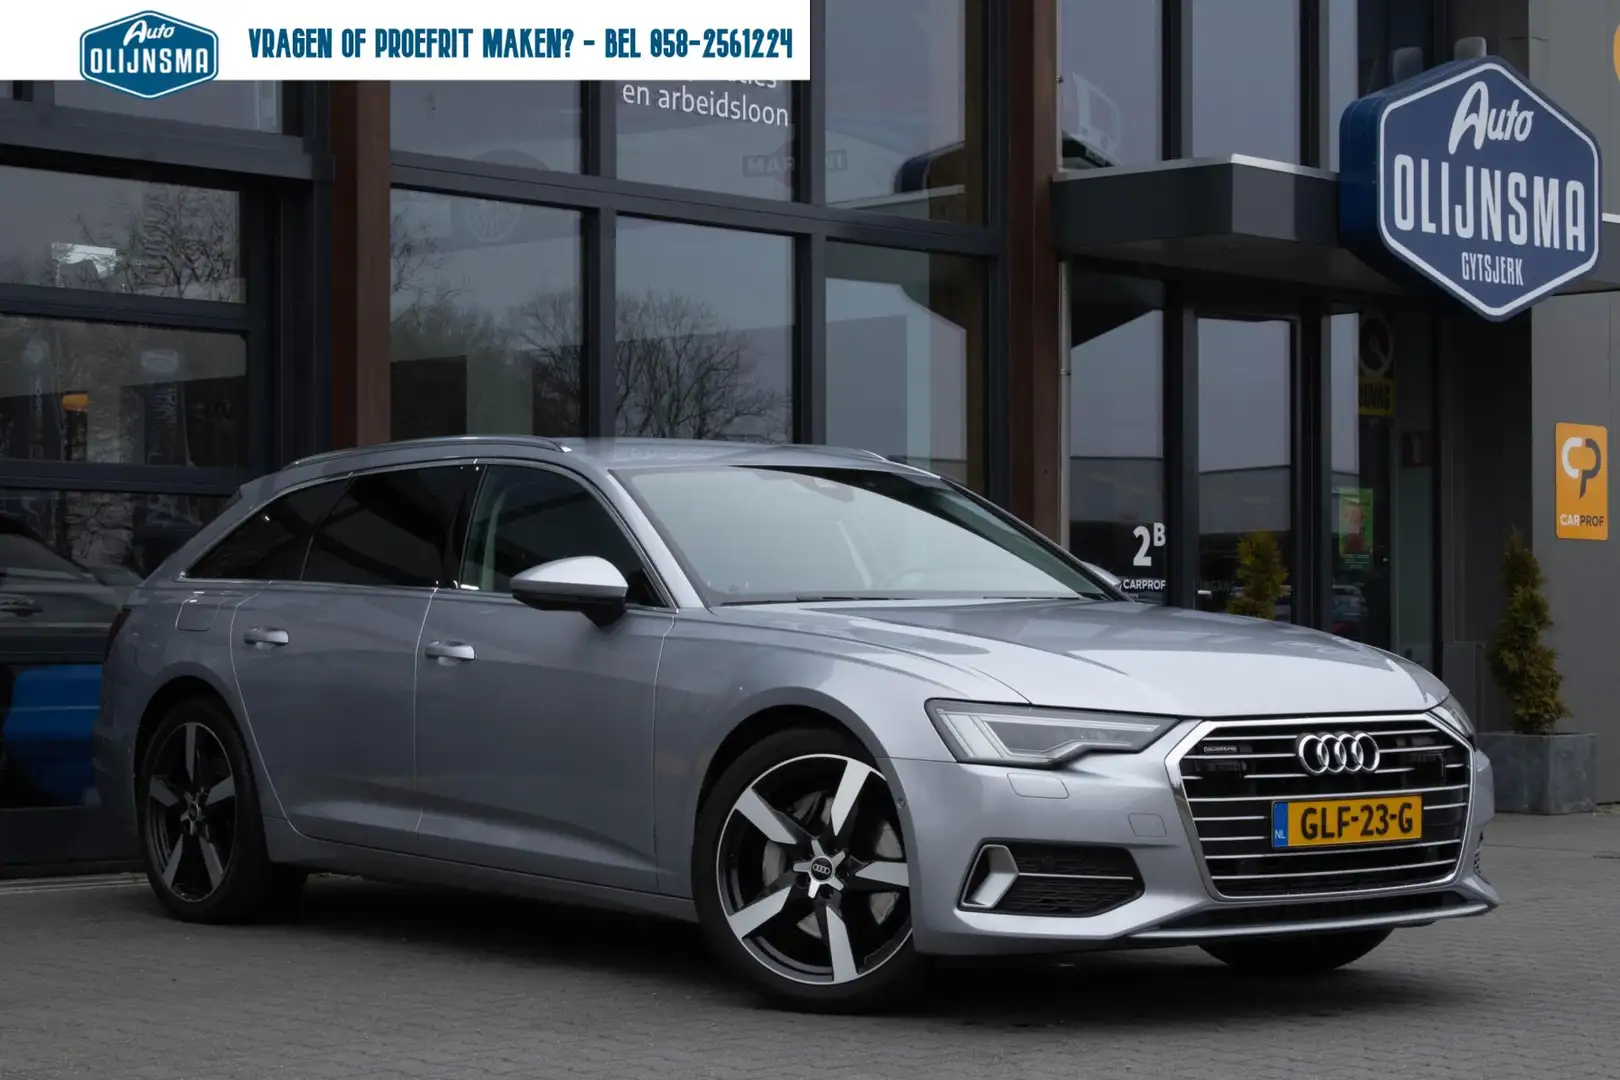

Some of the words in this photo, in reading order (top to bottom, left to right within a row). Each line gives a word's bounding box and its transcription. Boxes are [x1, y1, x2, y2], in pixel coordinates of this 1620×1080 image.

[622, 83, 650, 106] en
[657, 85, 789, 127] arbeidsloon
[1448, 81, 1534, 155] Auto
[1393, 153, 1586, 253] OLIJNSMA
[1461, 251, 1524, 287] GYTSJERK
[1560, 514, 1605, 527] CARPROF
[1122, 578, 1166, 590] CARPROF
[1274, 828, 1286, 840] NL
[1300, 802, 1413, 840] GLF-23-G
